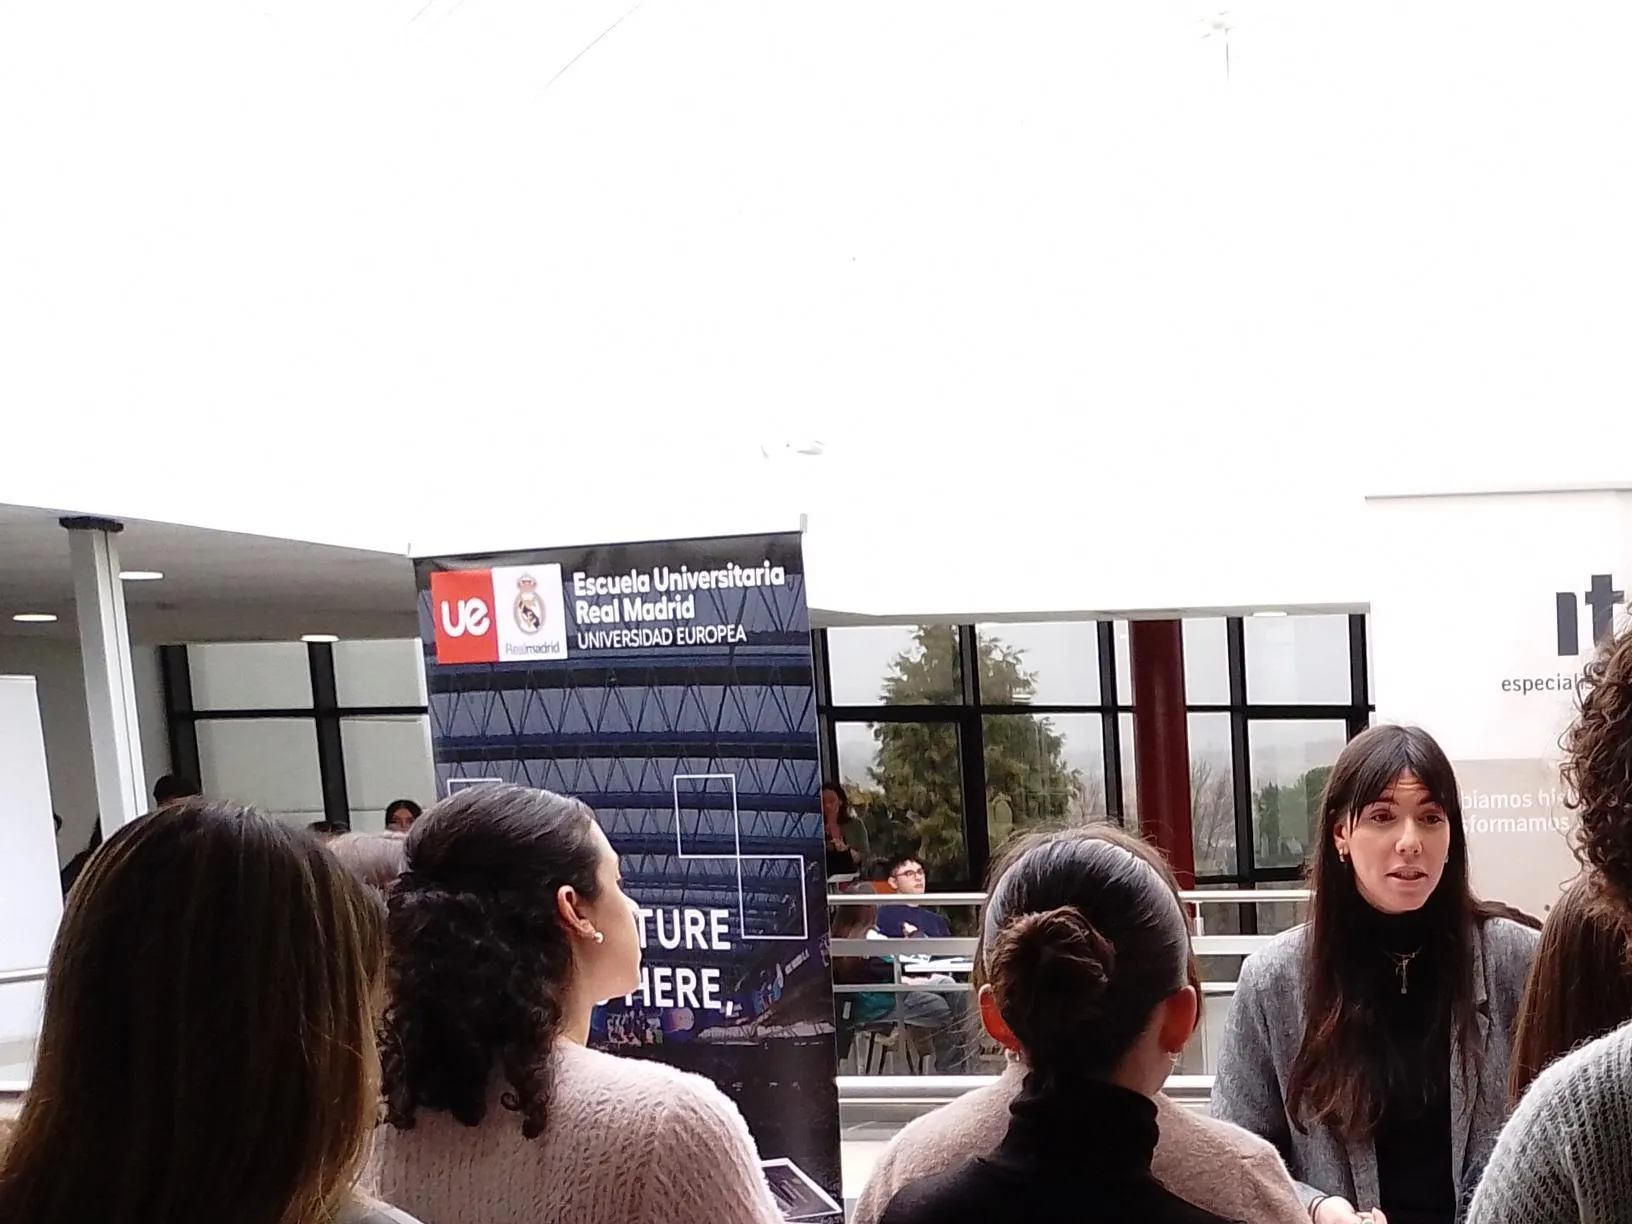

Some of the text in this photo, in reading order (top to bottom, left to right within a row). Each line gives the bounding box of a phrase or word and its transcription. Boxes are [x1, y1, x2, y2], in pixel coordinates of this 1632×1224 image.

[573, 561, 785, 597] Escuela Universitaria
[441, 597, 490, 637] ue
[576, 595, 695, 625] Real Madrid
[577, 624, 747, 650] UNIVERSIDAD EUROPEA
